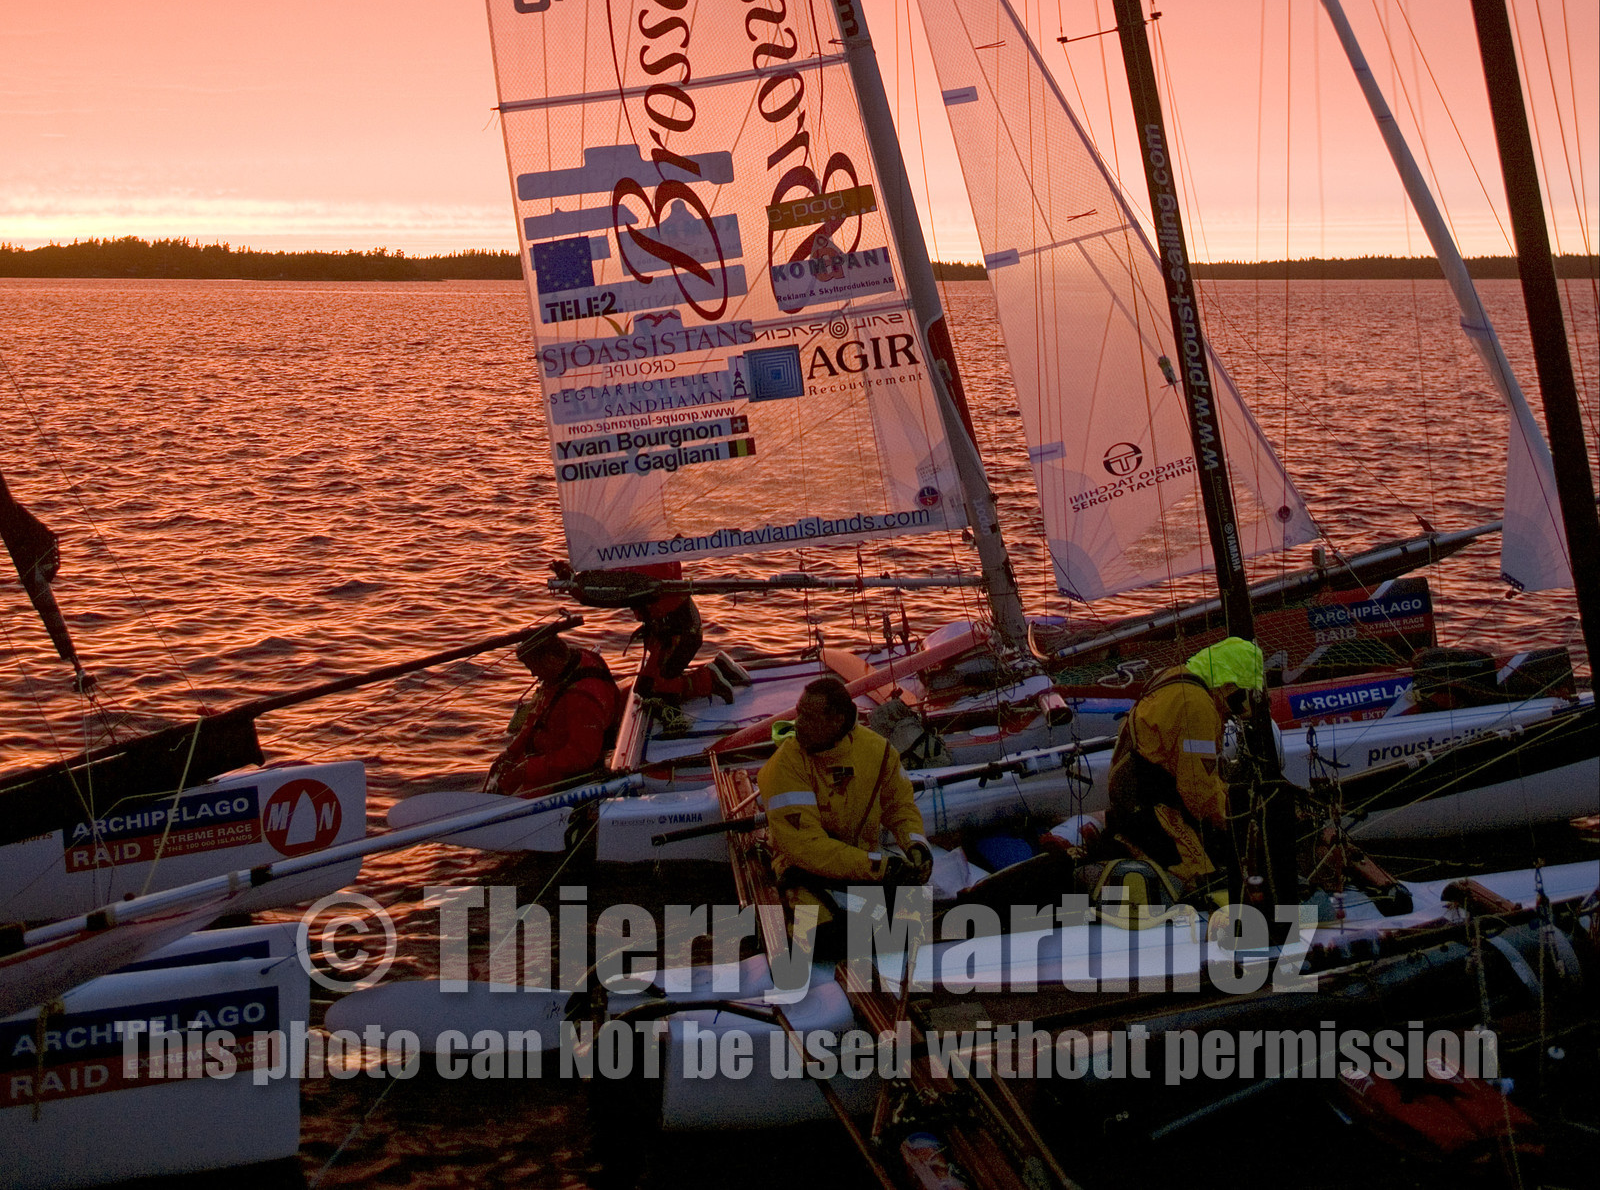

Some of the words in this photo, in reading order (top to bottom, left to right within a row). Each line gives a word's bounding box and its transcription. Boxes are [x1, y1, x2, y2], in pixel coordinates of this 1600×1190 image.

[545, 292, 619, 323] TELE2
[776, 291, 808, 302] Reklam
[809, 289, 816, 297] &
[1145, 123, 1219, 470] www.proust-sailing.com
[542, 321, 755, 375] SJÖASSISTANS
[807, 333, 920, 380] AGIR
[808, 372, 924, 397] Recouvrement
[604, 389, 723, 418] SANDHAMN
[557, 440, 611, 460] Yvan
[616, 423, 723, 452] Bourgnon
[561, 459, 629, 482] Olivier
[634, 443, 720, 472] Gagliani
[1072, 489, 1124, 513] SERGIO
[1128, 463, 1197, 493] TACCHINI
[597, 509, 931, 561] www.scandinavianislands.com
[1226, 533, 1242, 572] YAMAHA
[1314, 598, 1423, 624] ARCHIPELAGO
[1299, 683, 1414, 712] ARCHIPELA
[549, 785, 608, 809] YAMAHA
[72, 796, 250, 839] ARCHIPELAGO
[668, 812, 703, 824] YAMAHA
[152, 828, 214, 848] EXTREME
[217, 822, 253, 836] RACE
[167, 843, 184, 853] THE
[216, 834, 253, 845] ISLANDS
[72, 842, 142, 869] RAID
[10, 1002, 267, 1057] ARCHIPELAGO
[9, 1063, 110, 1100] RAID
